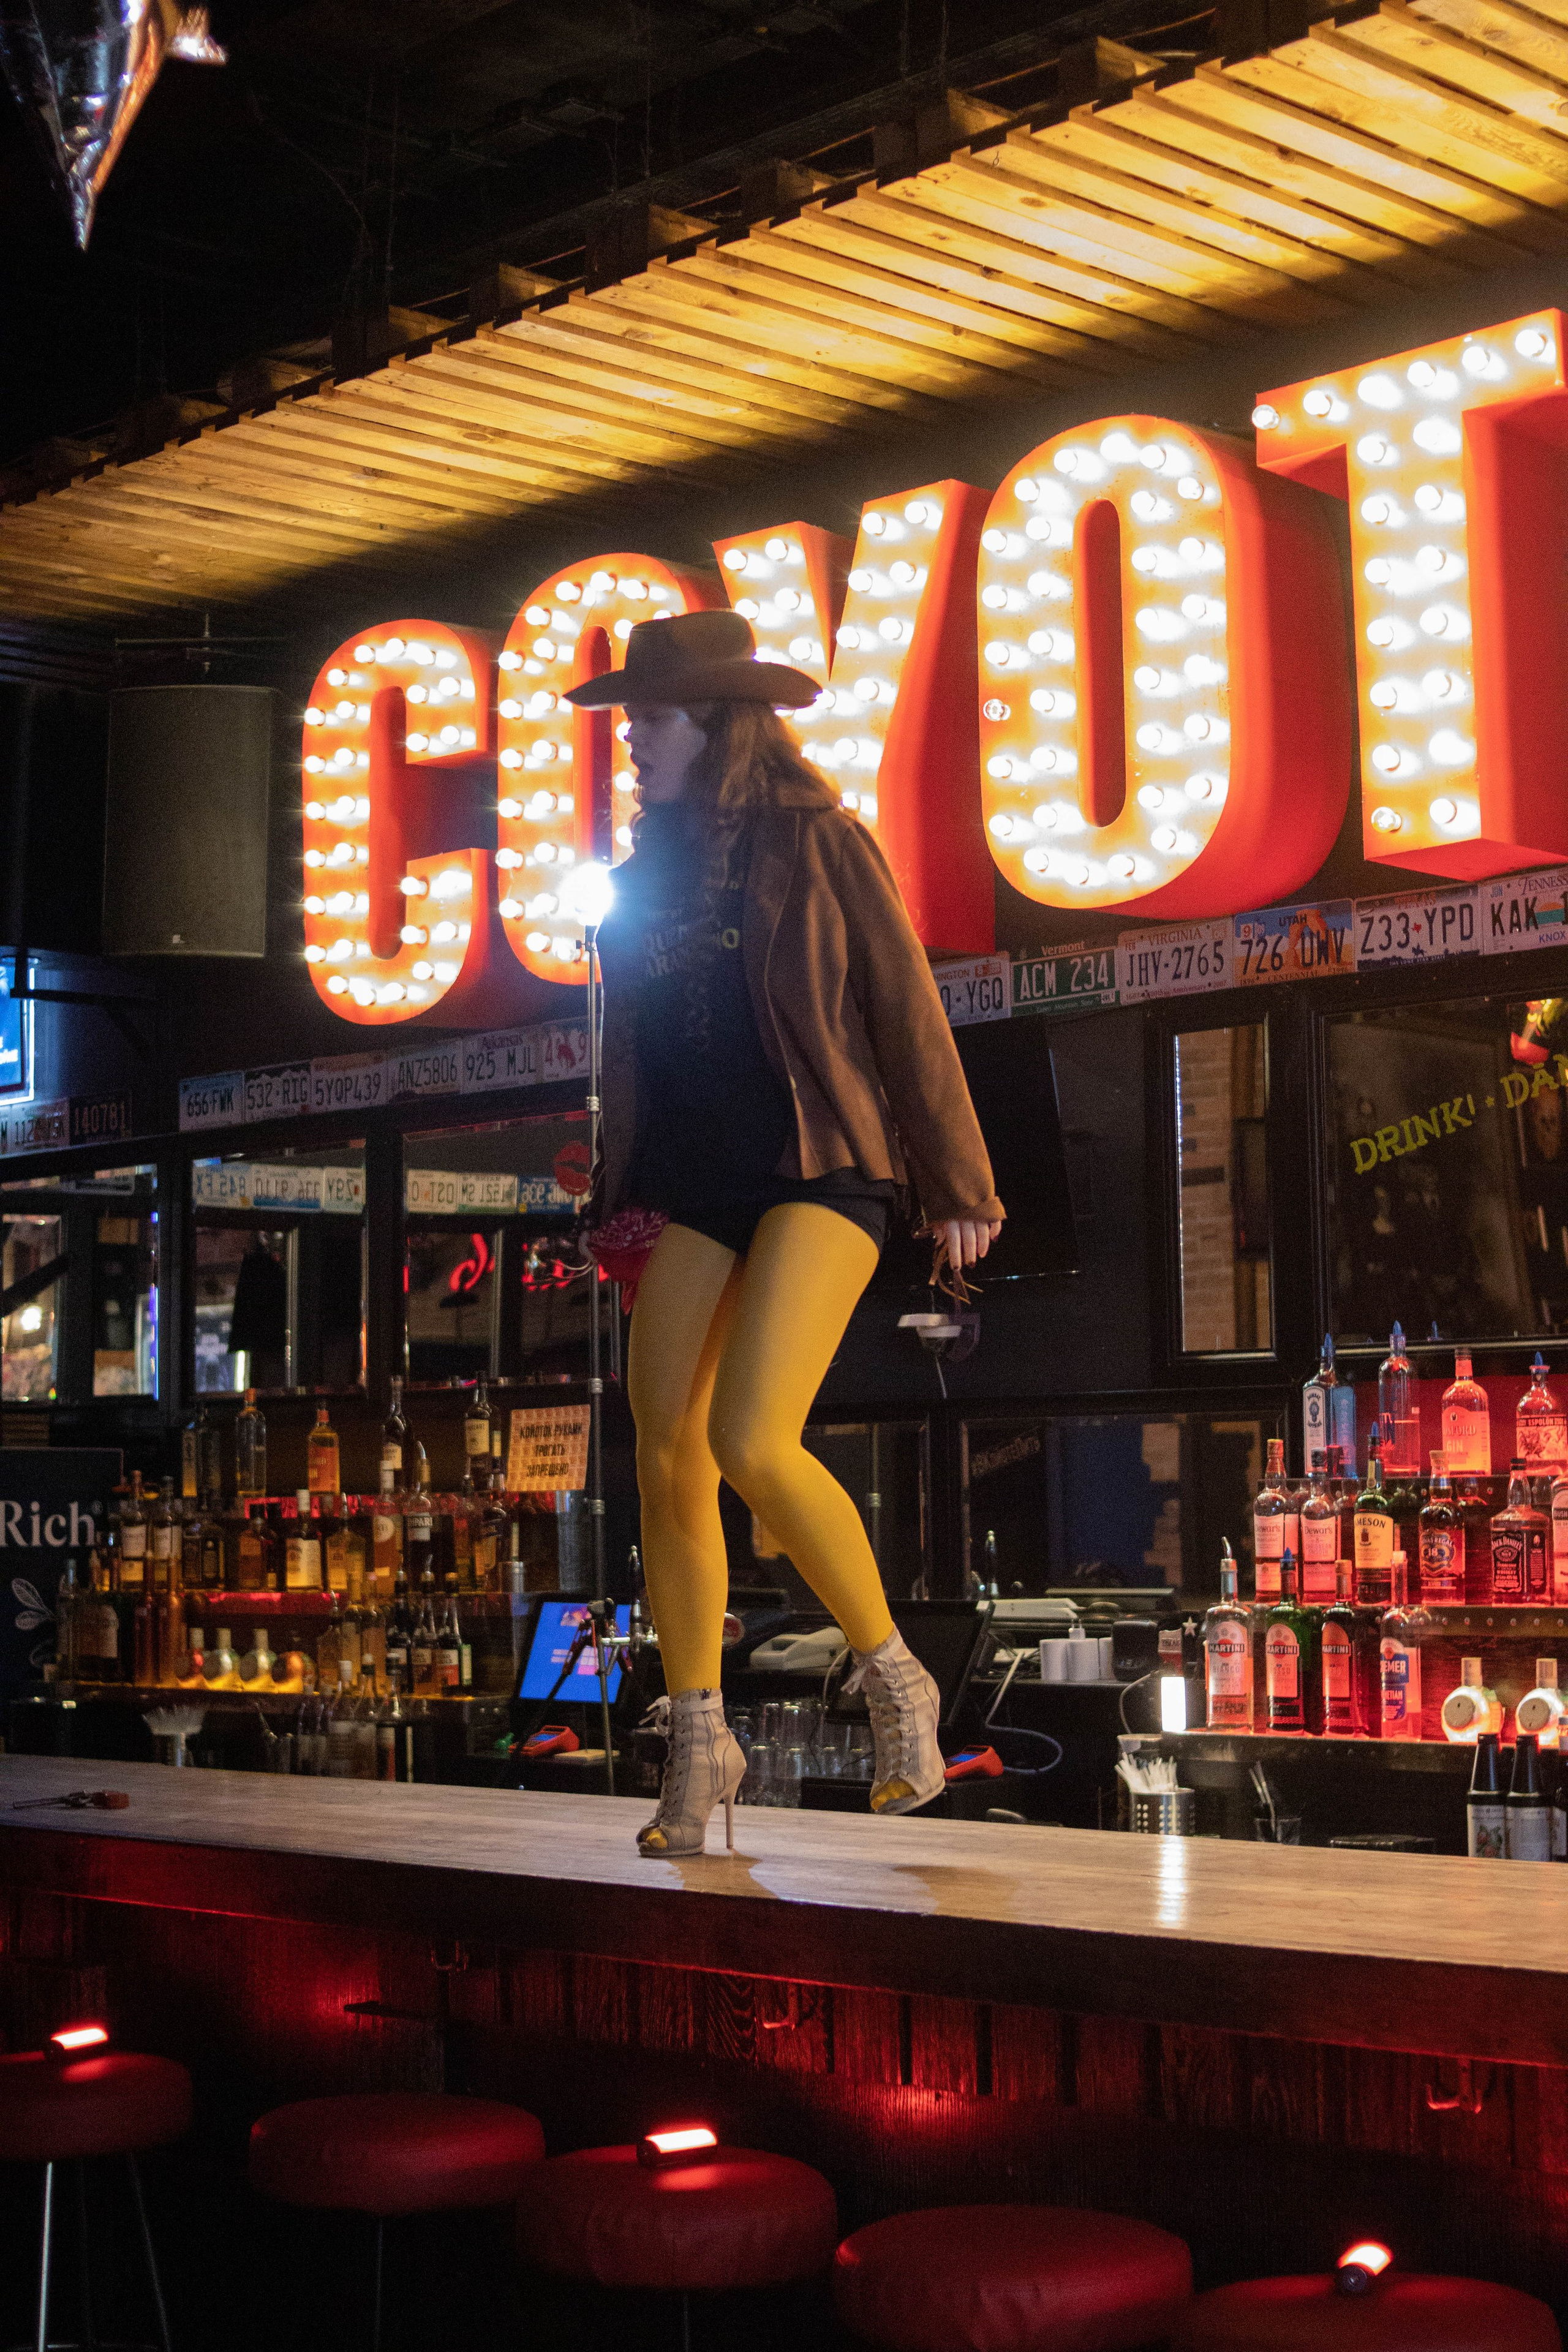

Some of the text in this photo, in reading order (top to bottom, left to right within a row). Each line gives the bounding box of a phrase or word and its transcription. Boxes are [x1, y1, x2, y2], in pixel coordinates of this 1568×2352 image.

[1278, 913, 1308, 927] UTAH
[1491, 896, 1539, 937] KAK
[1360, 903, 1474, 954] Z33 YPD
[1148, 927, 1202, 946] VIRGINIA
[1539, 931, 1566, 943] KNOX
[1042, 941, 1085, 956] Vermont
[1240, 935, 1284, 976] 726
[1020, 954, 1109, 1000] ACM 234
[466, 1046, 536, 1081] 925 MJL
[535, 1443, 565, 1457] ТРОГАТЬ
[1446, 1441, 1463, 1452] GIN
[526, 1463, 569, 1477] ЗАПРЕЩЕНО
[0, 1500, 96, 1547] Rich
[1208, 1643, 1245, 1653] MARTINI
[1267, 1644, 1298, 1654] MARTINI
[1322, 1645, 1349, 1654] MARTINI
